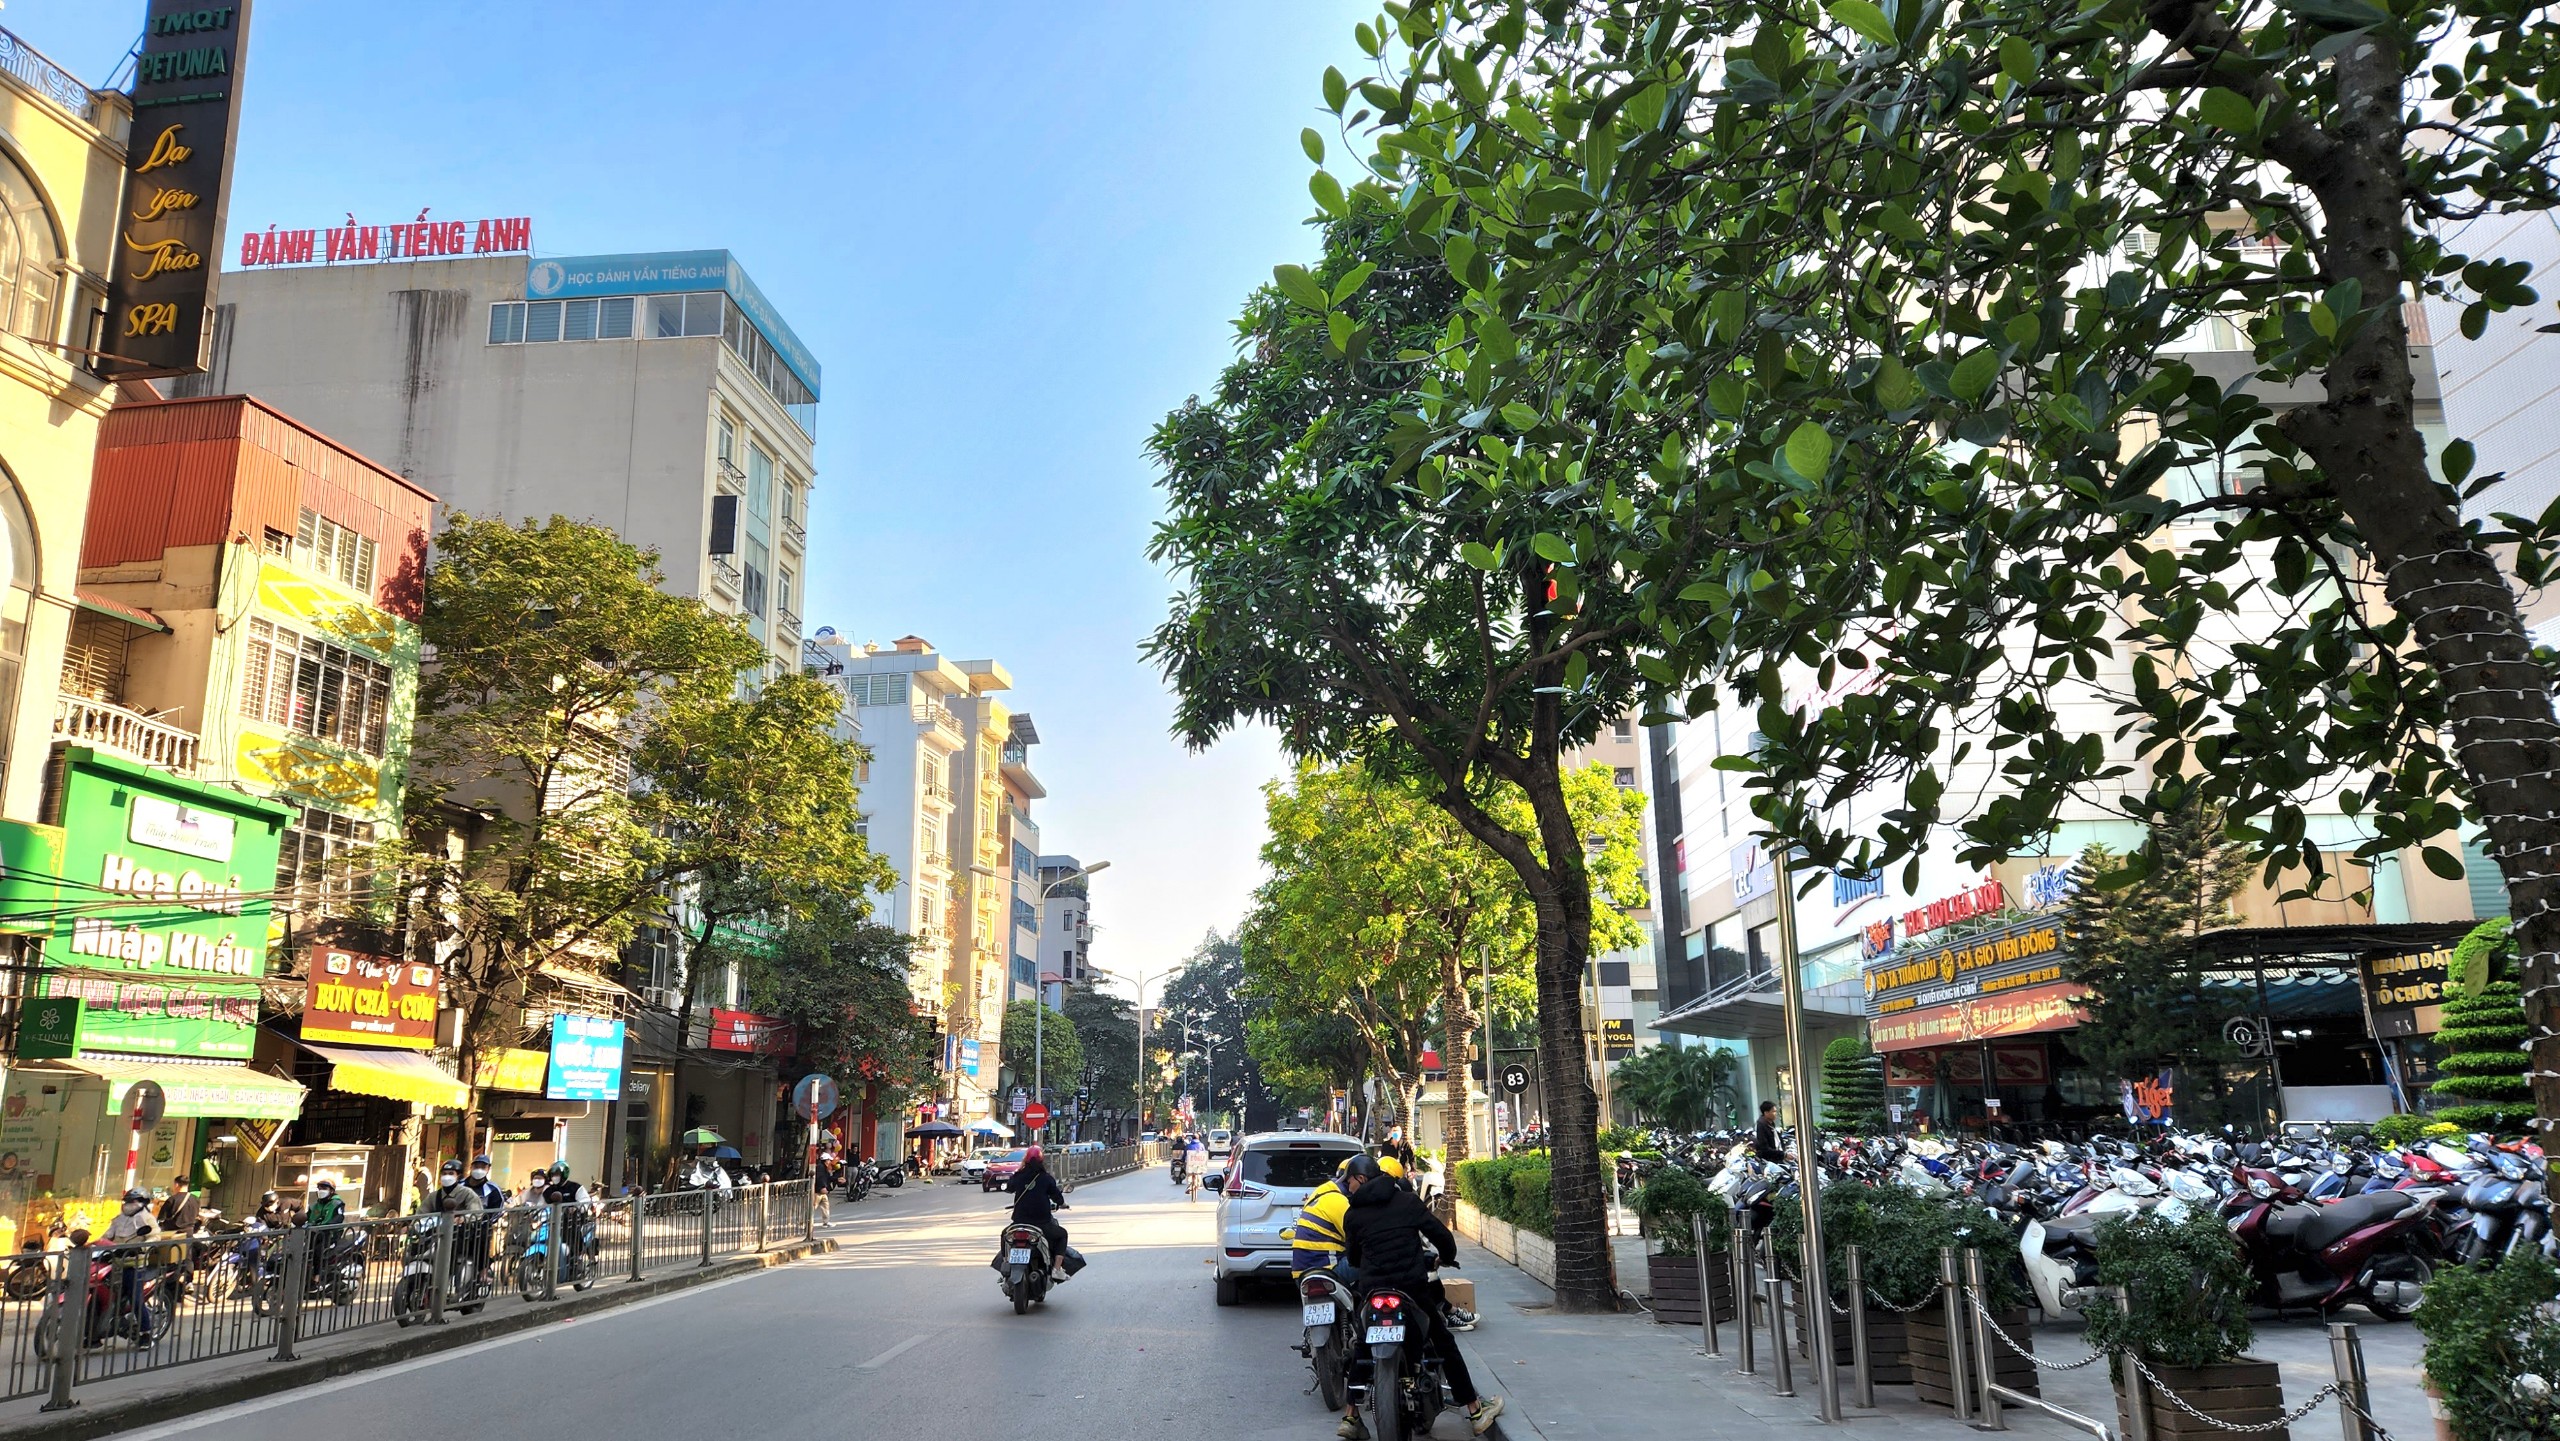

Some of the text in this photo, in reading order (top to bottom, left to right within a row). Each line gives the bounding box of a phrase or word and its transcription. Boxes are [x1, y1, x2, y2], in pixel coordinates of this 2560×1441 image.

[150, 6, 233, 36] TMQT
[140, 46, 227, 83] PETUNIA
[135, 123, 193, 174] Dạ
[240, 207, 531, 267] ĐÁNH VẦN TIẾNG ANH
[124, 231, 200, 281] Thảo
[567, 264, 726, 287] HỌC ĐÁNH VẦN TIẾNG ANH
[124, 302, 178, 338] SPA
[101, 853, 175, 901] Hoa
[1903, 909, 1926, 938] BIA
[1926, 896, 1951, 932] HƠI
[1950, 882, 1975, 922] HÀ
[1974, 874, 2005, 919] NỘI
[70, 915, 164, 969] Nhập
[1957, 927, 2057, 971] CÁ GIÒ VIỄN ĐÔNG
[2372, 944, 2455, 976] NHẬN ĐẶT
[1888, 971, 1899, 988] TA
[1897, 956, 1920, 986] TUẤN
[1919, 955, 1938, 982] RÂU
[118, 982, 164, 1020] KẸO
[166, 984, 210, 1020] CÁC
[314, 977, 355, 1014] BÚN
[353, 981, 391, 1018] CHẢ
[399, 992, 437, 1022] CƠM
[2373, 978, 2394, 1006] TỔ
[2394, 976, 2440, 1003] CHỨC
[25, 1032, 70, 1043] PETUNIA
[1507, 1072, 1525, 1086] 83
[2133, 1076, 2174, 1118] Tiger
[1305, 1313, 1332, 1325] 547.72
[1308, 1304, 1330, 1315] 29-Y3
[1370, 1334, 1402, 1342] 154.40
[1373, 1326, 1399, 1335] 37-K1
